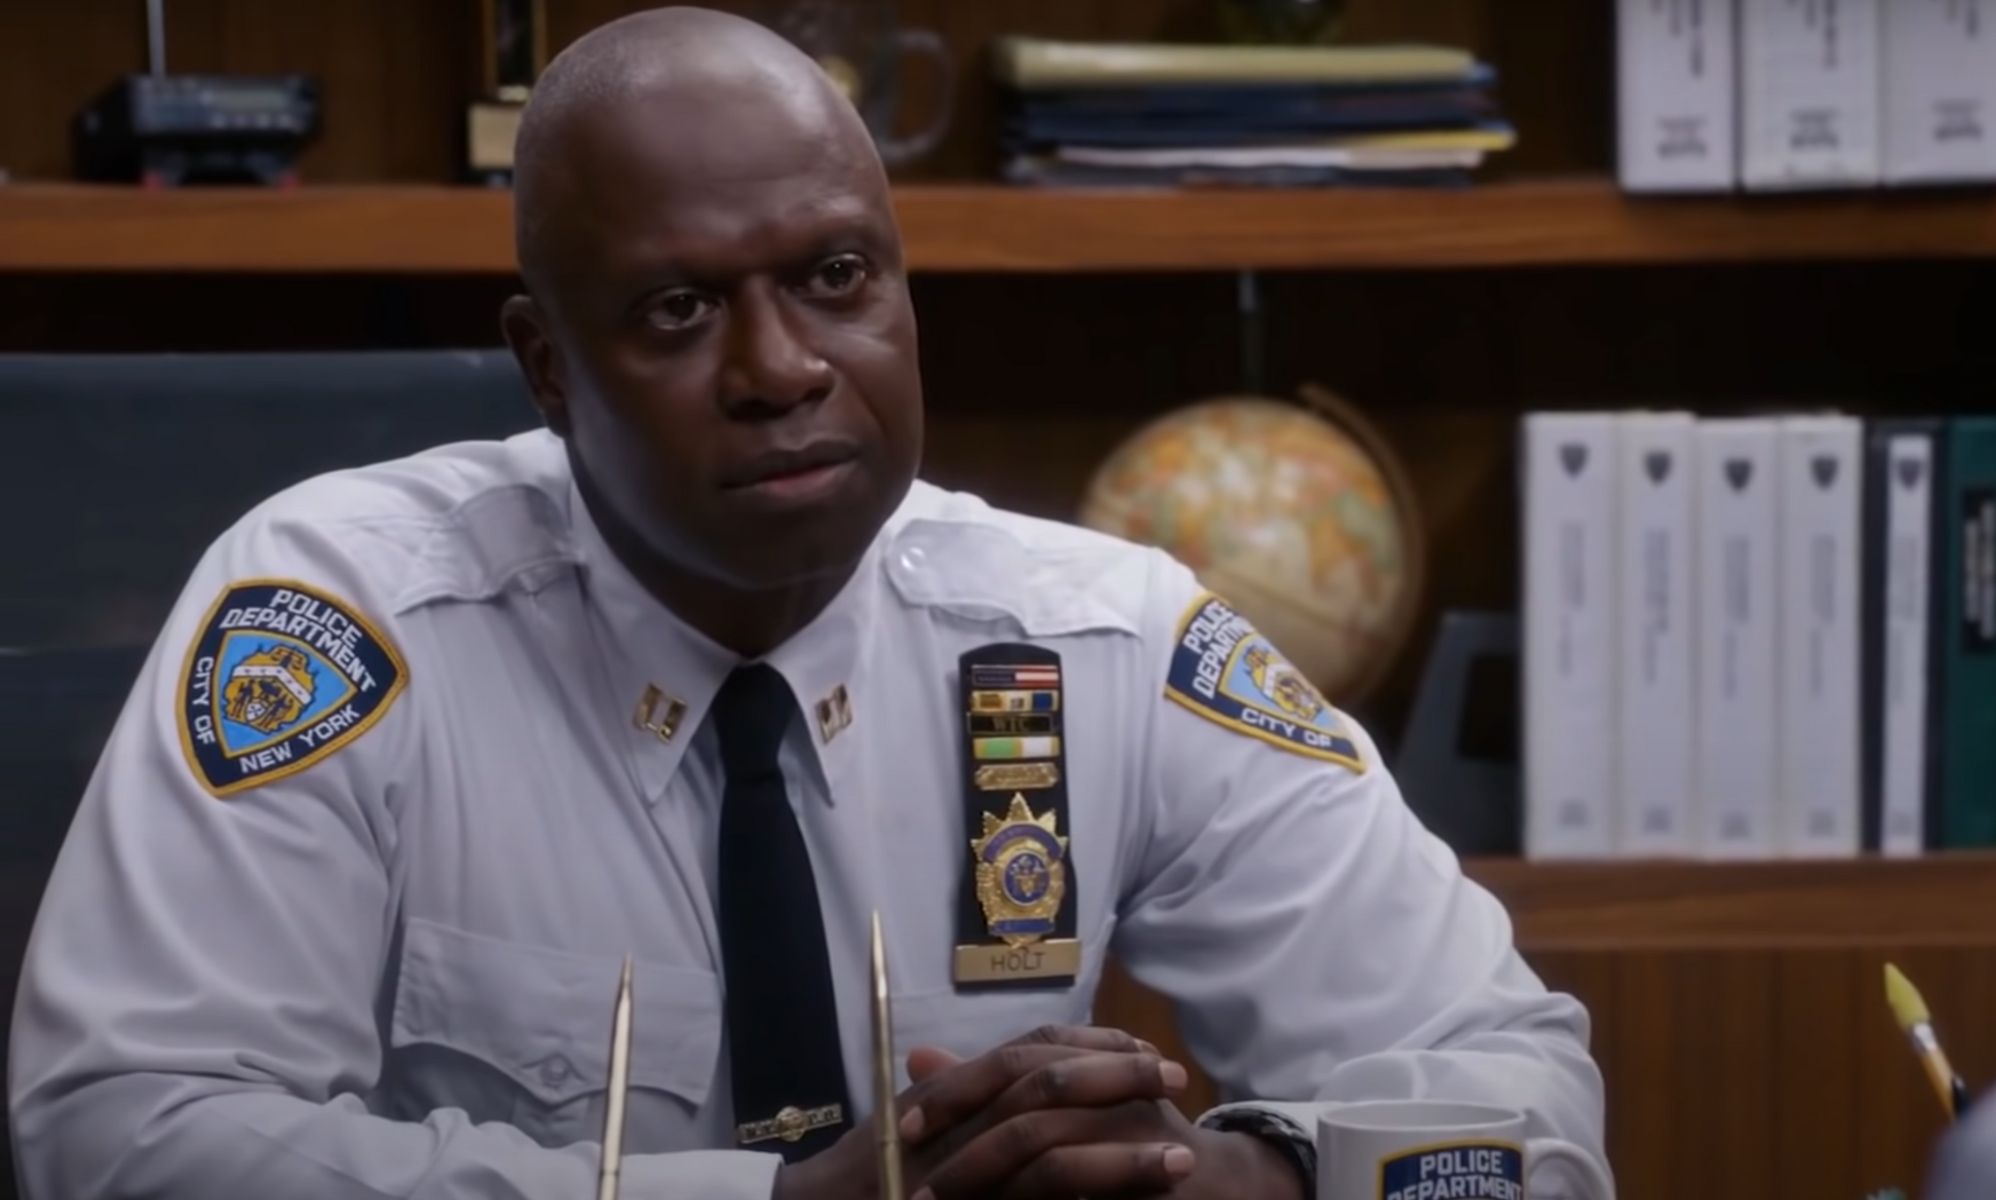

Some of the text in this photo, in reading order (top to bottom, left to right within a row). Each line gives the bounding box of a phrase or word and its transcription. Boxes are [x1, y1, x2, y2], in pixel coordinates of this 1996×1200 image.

[270, 589, 362, 649] POLICE
[1183, 600, 1234, 655] POLIC
[219, 607, 377, 693] DEPARTMENT
[192, 656, 216, 744] CITY OF
[1241, 707, 1332, 747] CITY OF
[239, 704, 360, 773] NEW YORK
[990, 952, 1045, 971] HOLT
[1419, 1149, 1503, 1180] POLICE
